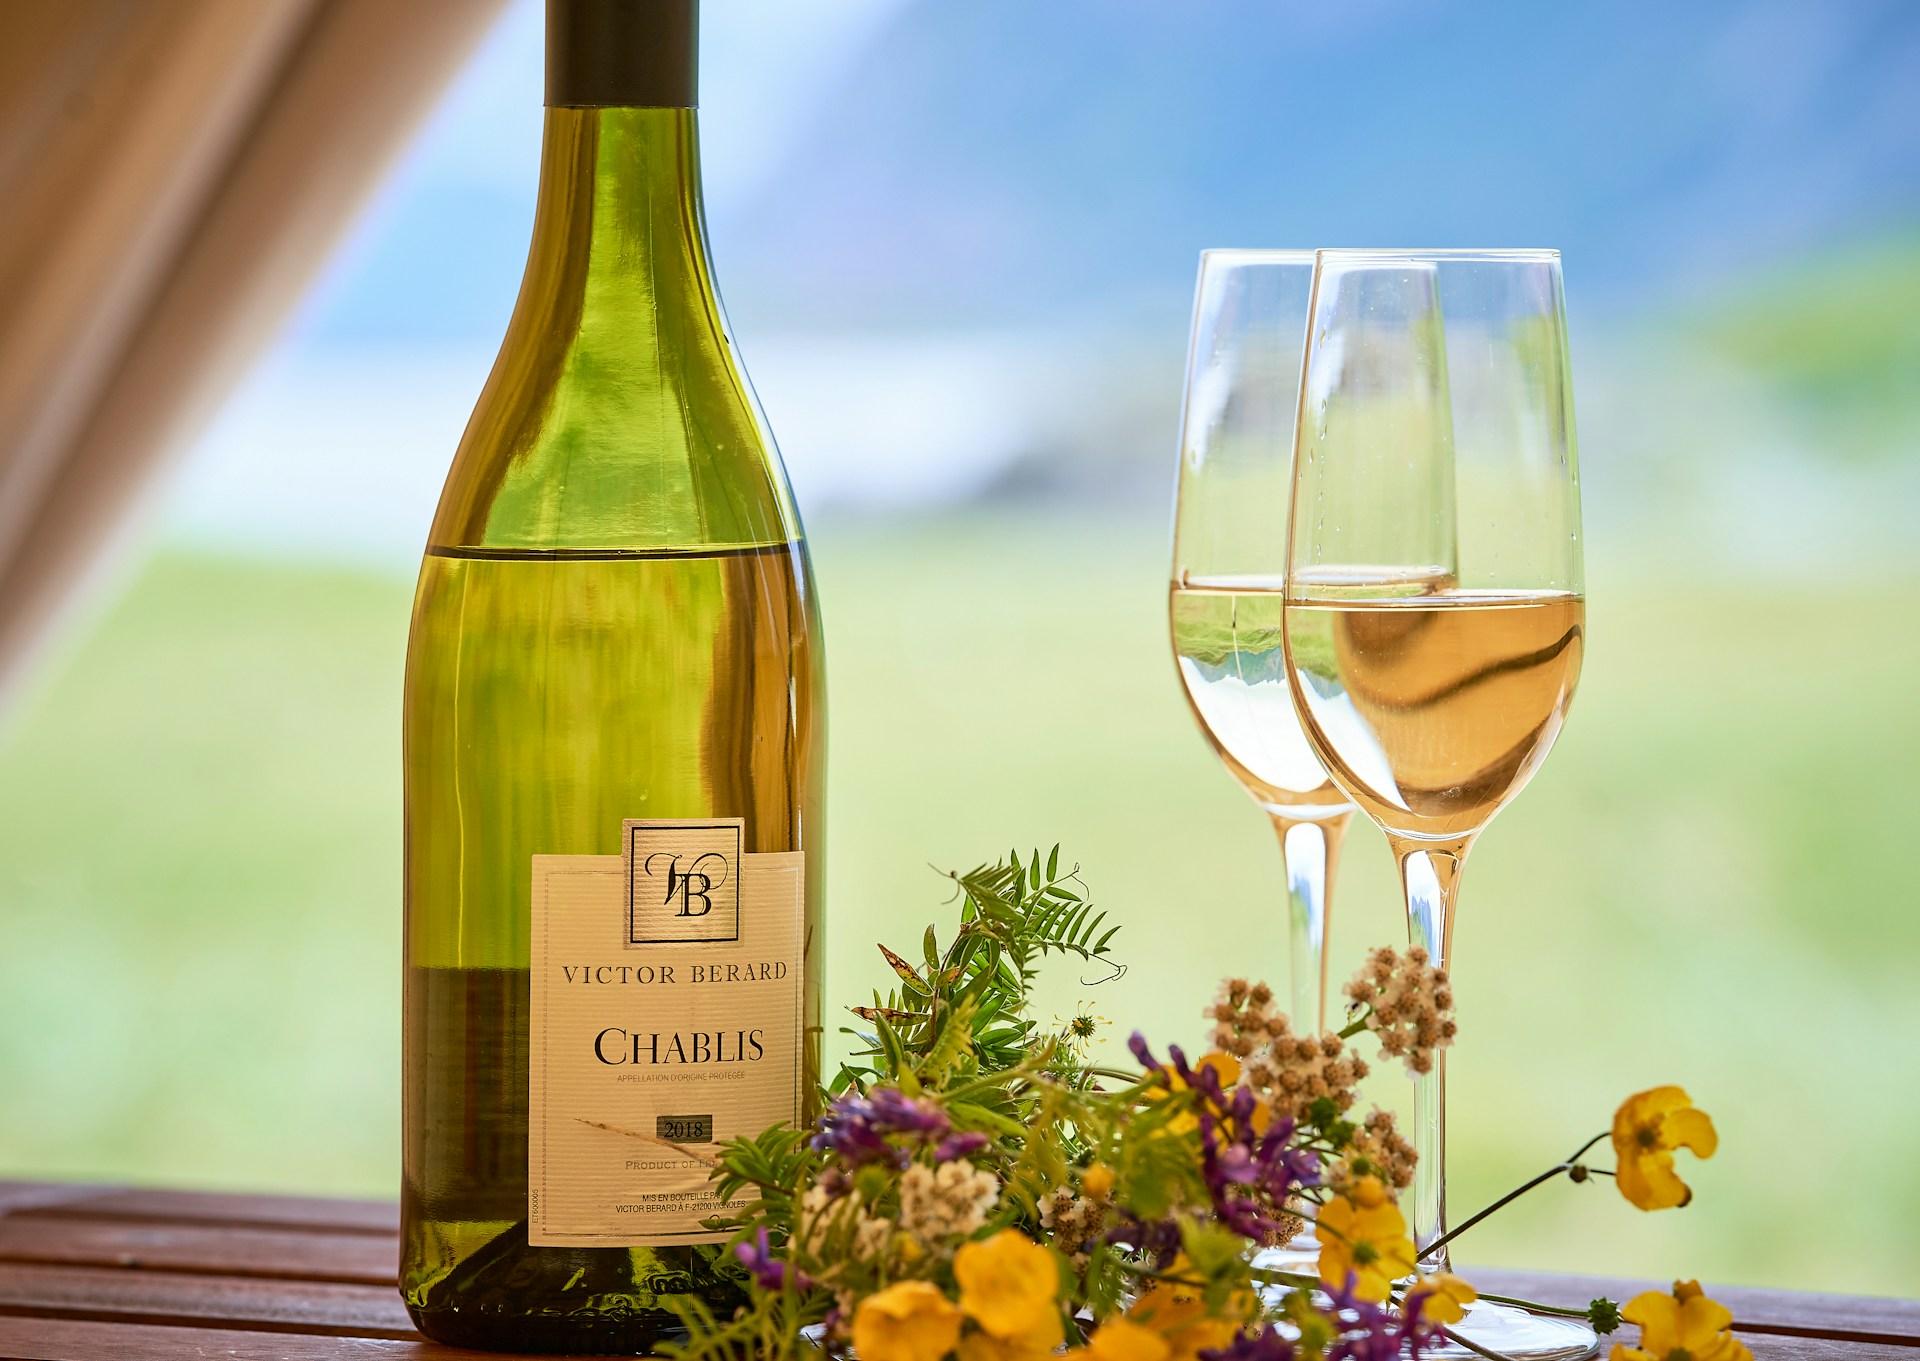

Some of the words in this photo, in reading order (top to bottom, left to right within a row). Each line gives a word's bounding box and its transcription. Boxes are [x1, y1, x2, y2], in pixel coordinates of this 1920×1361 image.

[561, 965, 676, 985] VICTOR
[690, 961, 788, 983] BERARD
[593, 1027, 764, 1065] CHABLIS
[616, 1073, 669, 1083] APPELLATION
[670, 1072, 708, 1082] D'ORIGINE
[664, 1121, 703, 1138] 2018
[625, 1161, 678, 1170] PRODUCT
[681, 1160, 694, 1169] OF
[642, 1193, 657, 1202] MIS
[658, 1193, 669, 1202] EN
[670, 1191, 709, 1201] BOUTEILLE
[531, 1188, 539, 1224] ET600005
[615, 1205, 645, 1213] VICTOR
[646, 1204, 677, 1213] BERARD
[678, 1202, 684, 1211] À
[685, 1203, 712, 1212] F-21200
